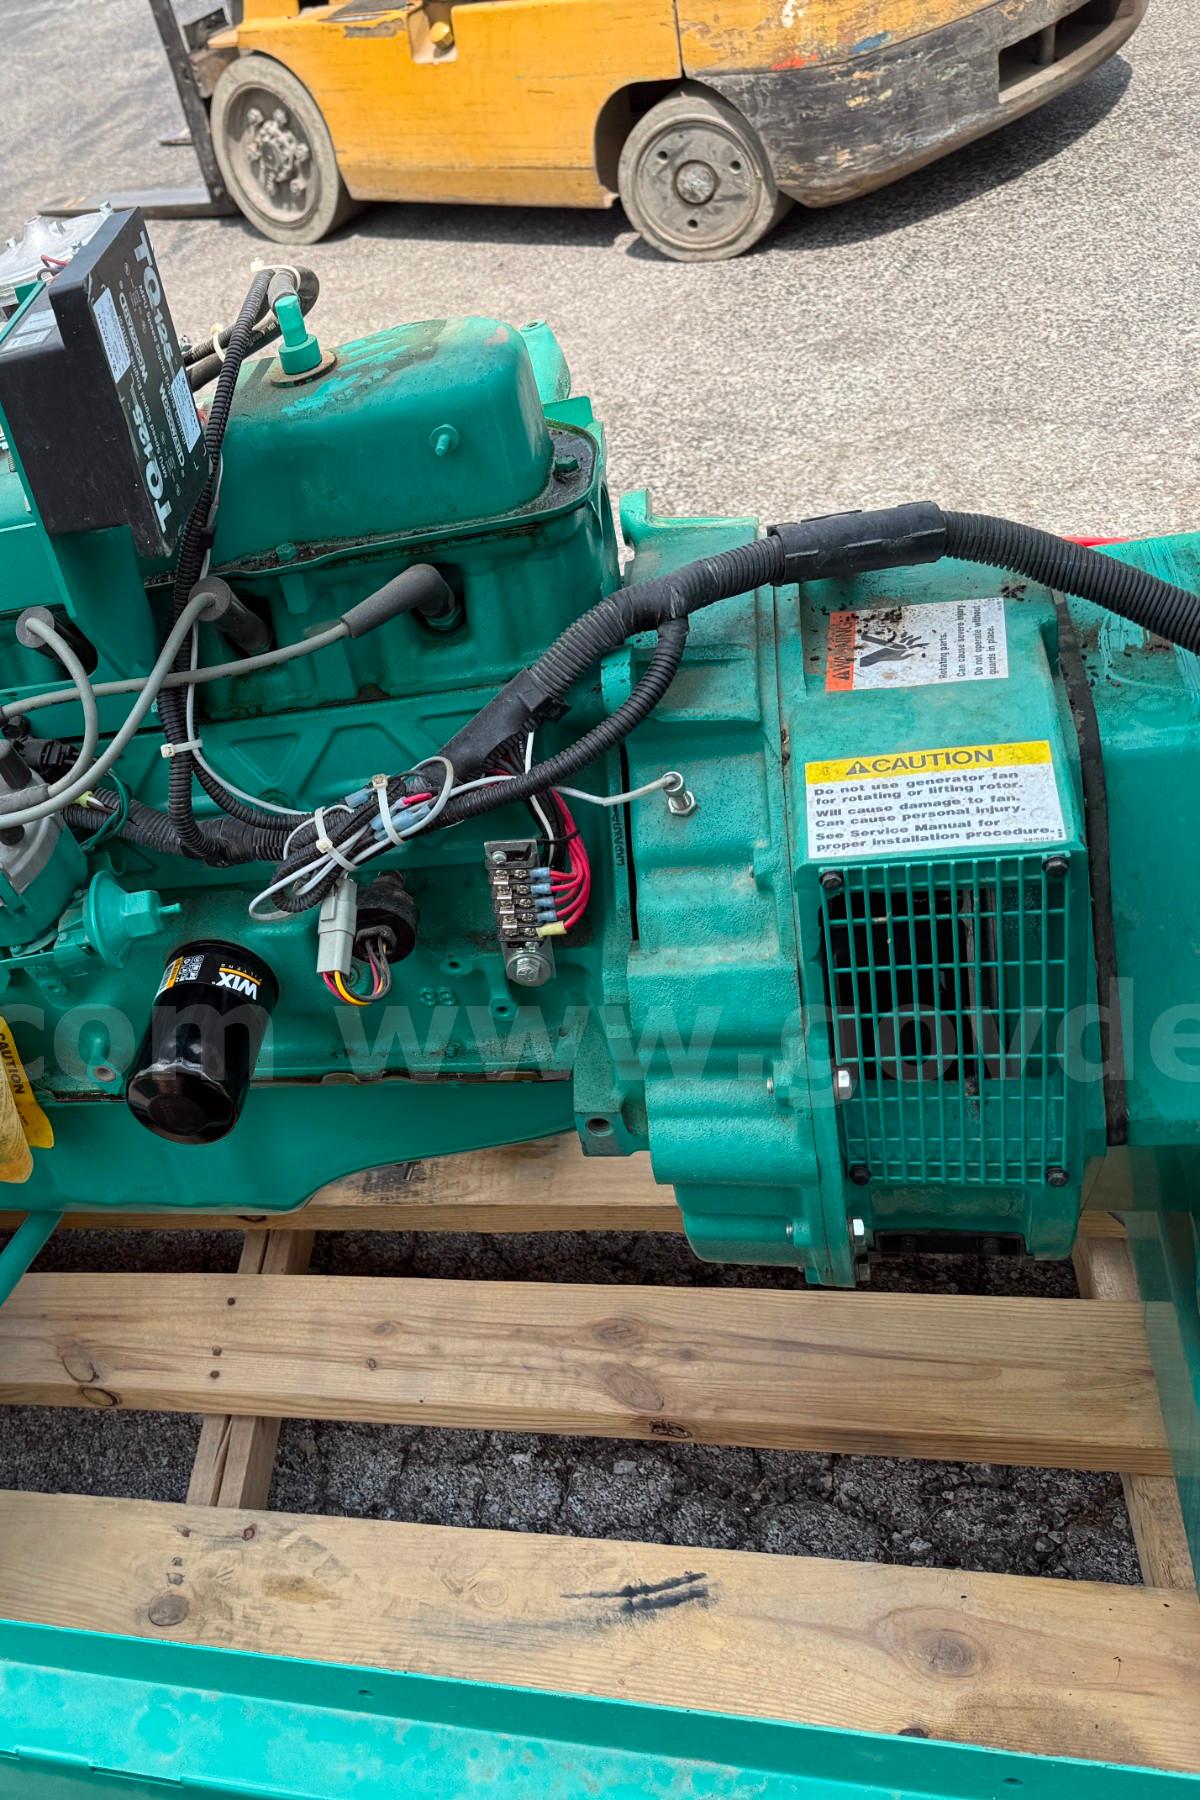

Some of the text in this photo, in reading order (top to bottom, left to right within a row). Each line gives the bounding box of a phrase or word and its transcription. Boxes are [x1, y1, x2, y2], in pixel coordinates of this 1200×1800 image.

[971, 605, 983, 675] Do not operate without
[986, 625, 995, 643] place.
[939, 632, 949, 678] Rotating parts.
[957, 644, 965, 662] cause
[987, 652, 997, 674] guards
[956, 664, 965, 677] Can
[871, 748, 994, 772] CAUTION
[814, 770, 1018, 795] Do not use generator fan
[816, 797, 836, 805] for
[842, 791, 900, 803] rotating
[928, 784, 973, 795] lifting
[979, 780, 1023, 790] rotor.
[815, 803, 1025, 827] Can cause personal injury.
[816, 793, 1020, 817] Will cause damage to fan.
[816, 818, 1000, 840] See Service Manual for
[816, 839, 866, 850] proper
[872, 831, 959, 845] installation
[965, 825, 1054, 839] procedure.
[215, 972, 257, 1000] WIX
